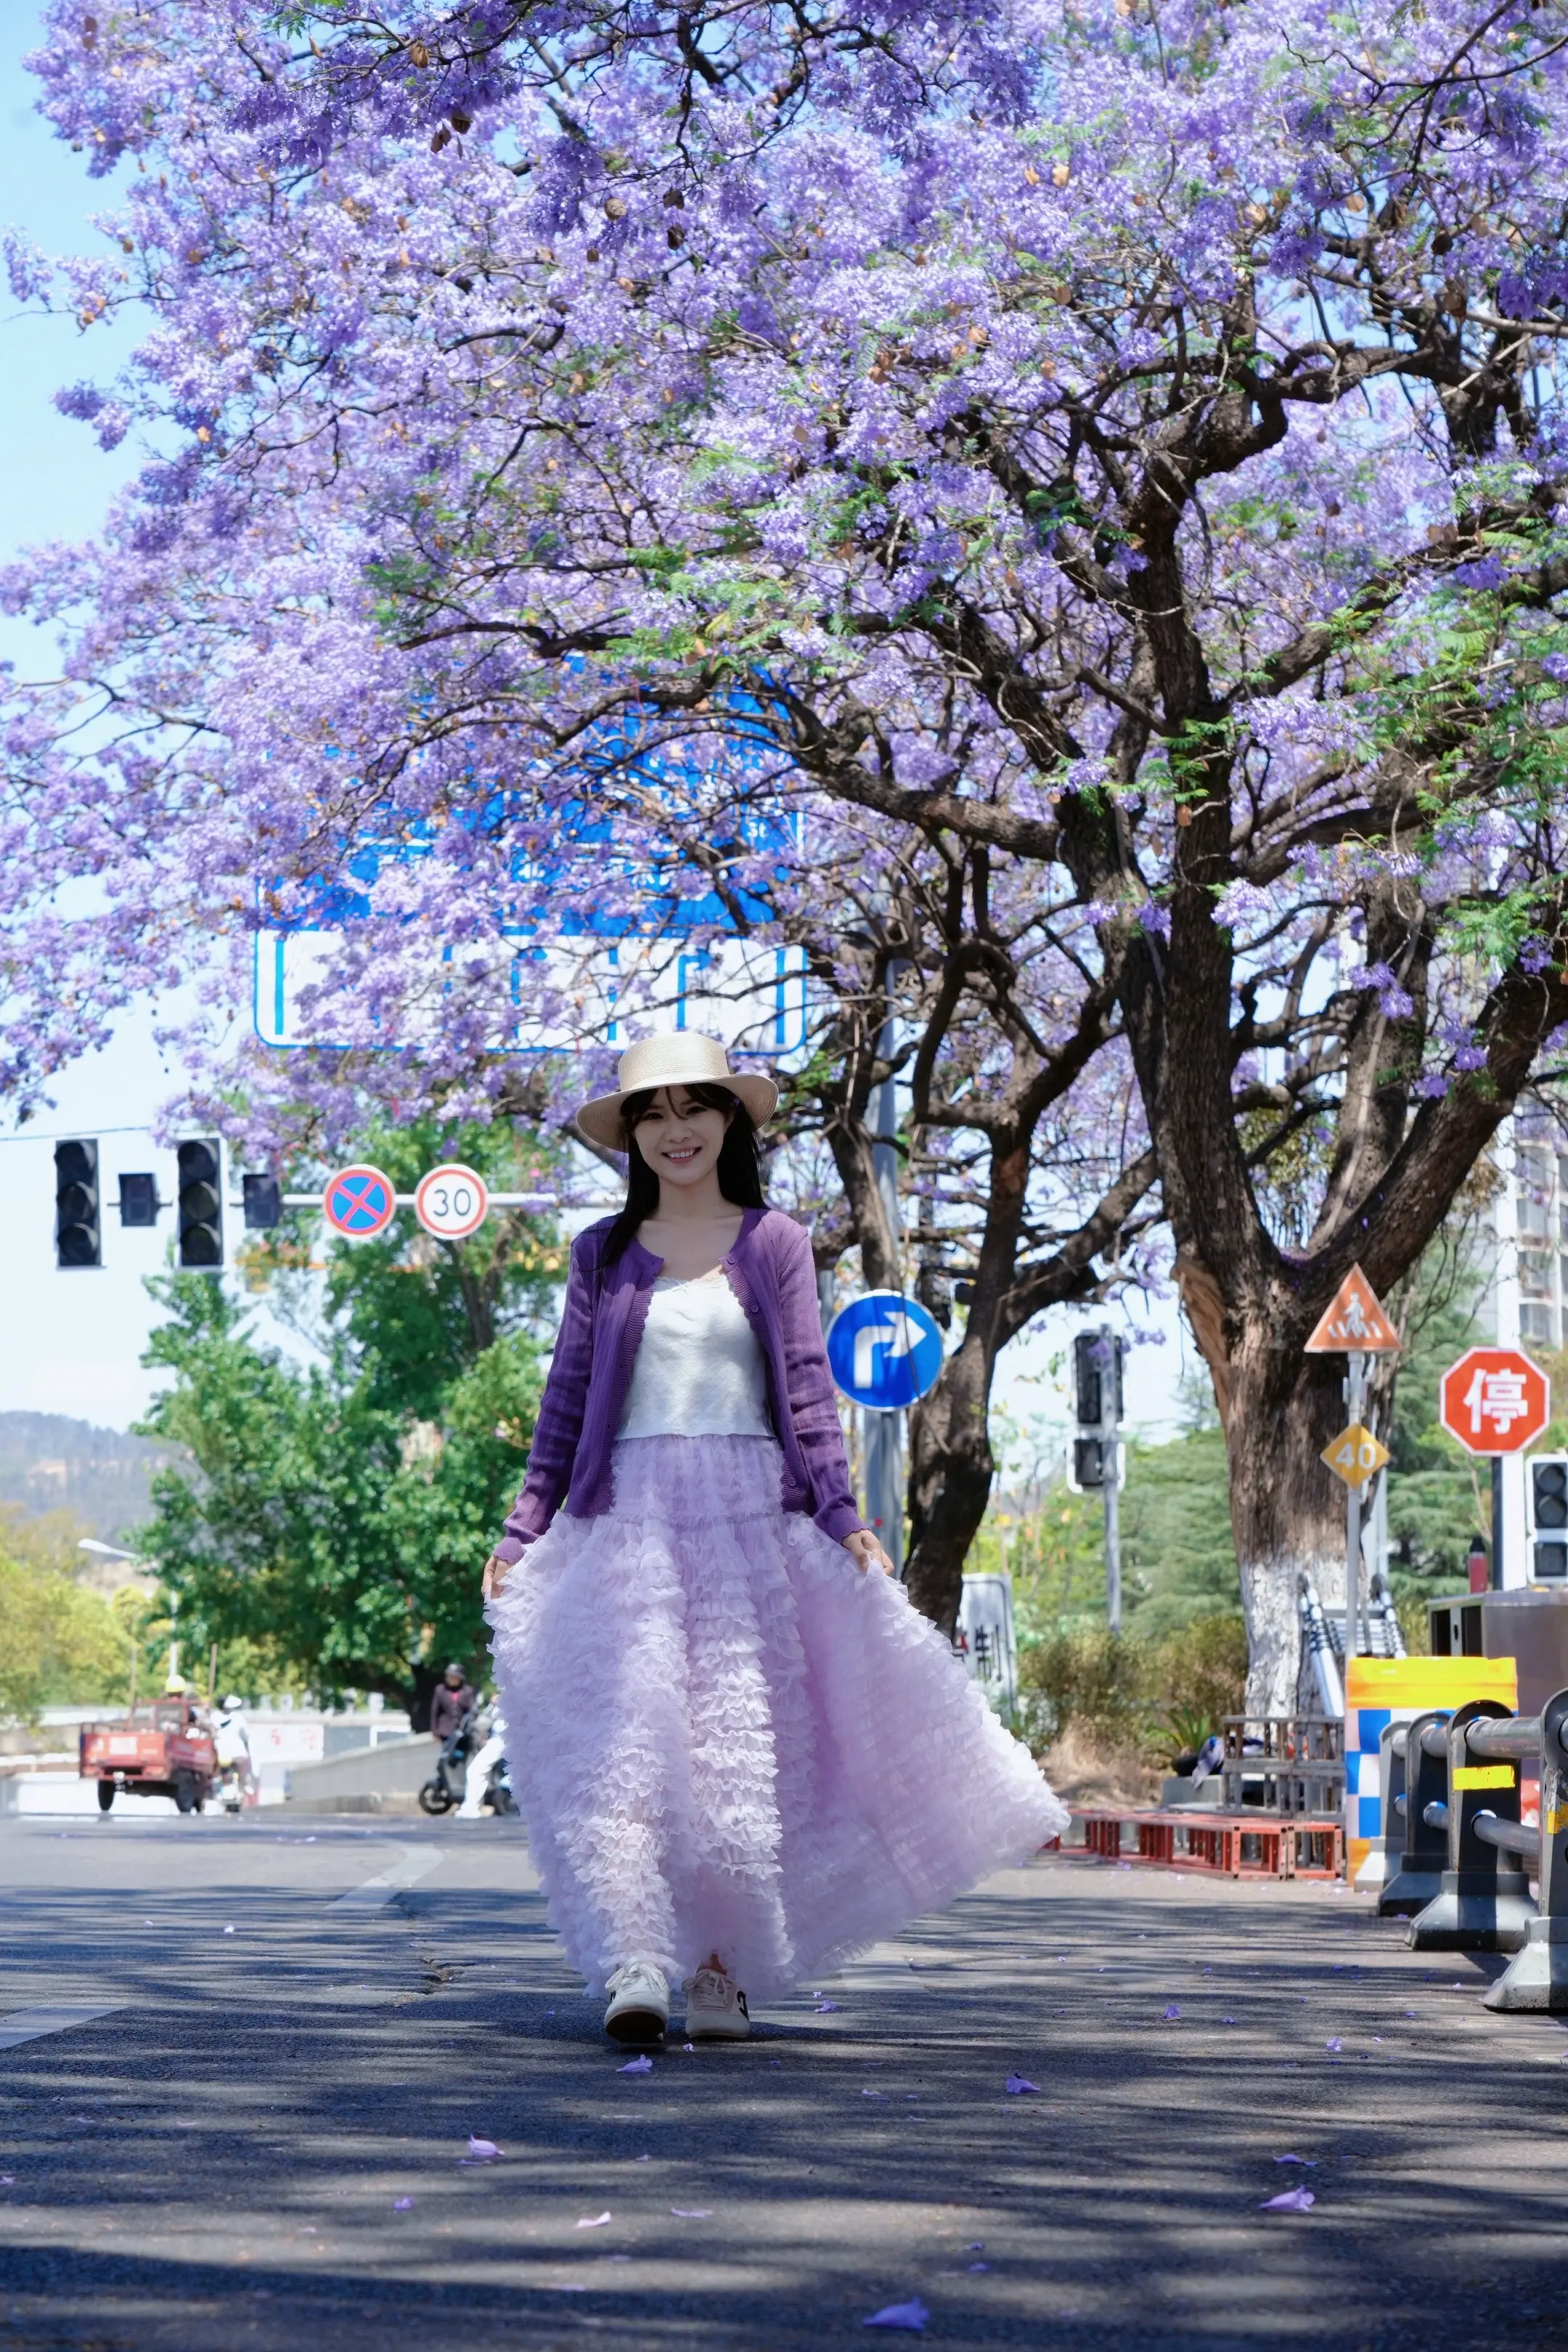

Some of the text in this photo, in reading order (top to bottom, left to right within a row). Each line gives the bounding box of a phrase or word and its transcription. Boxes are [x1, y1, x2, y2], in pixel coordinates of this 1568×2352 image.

[433, 1188, 470, 1217] 30
[1462, 1368, 1529, 1435] 停
[1335, 1442, 1376, 1470] 40
